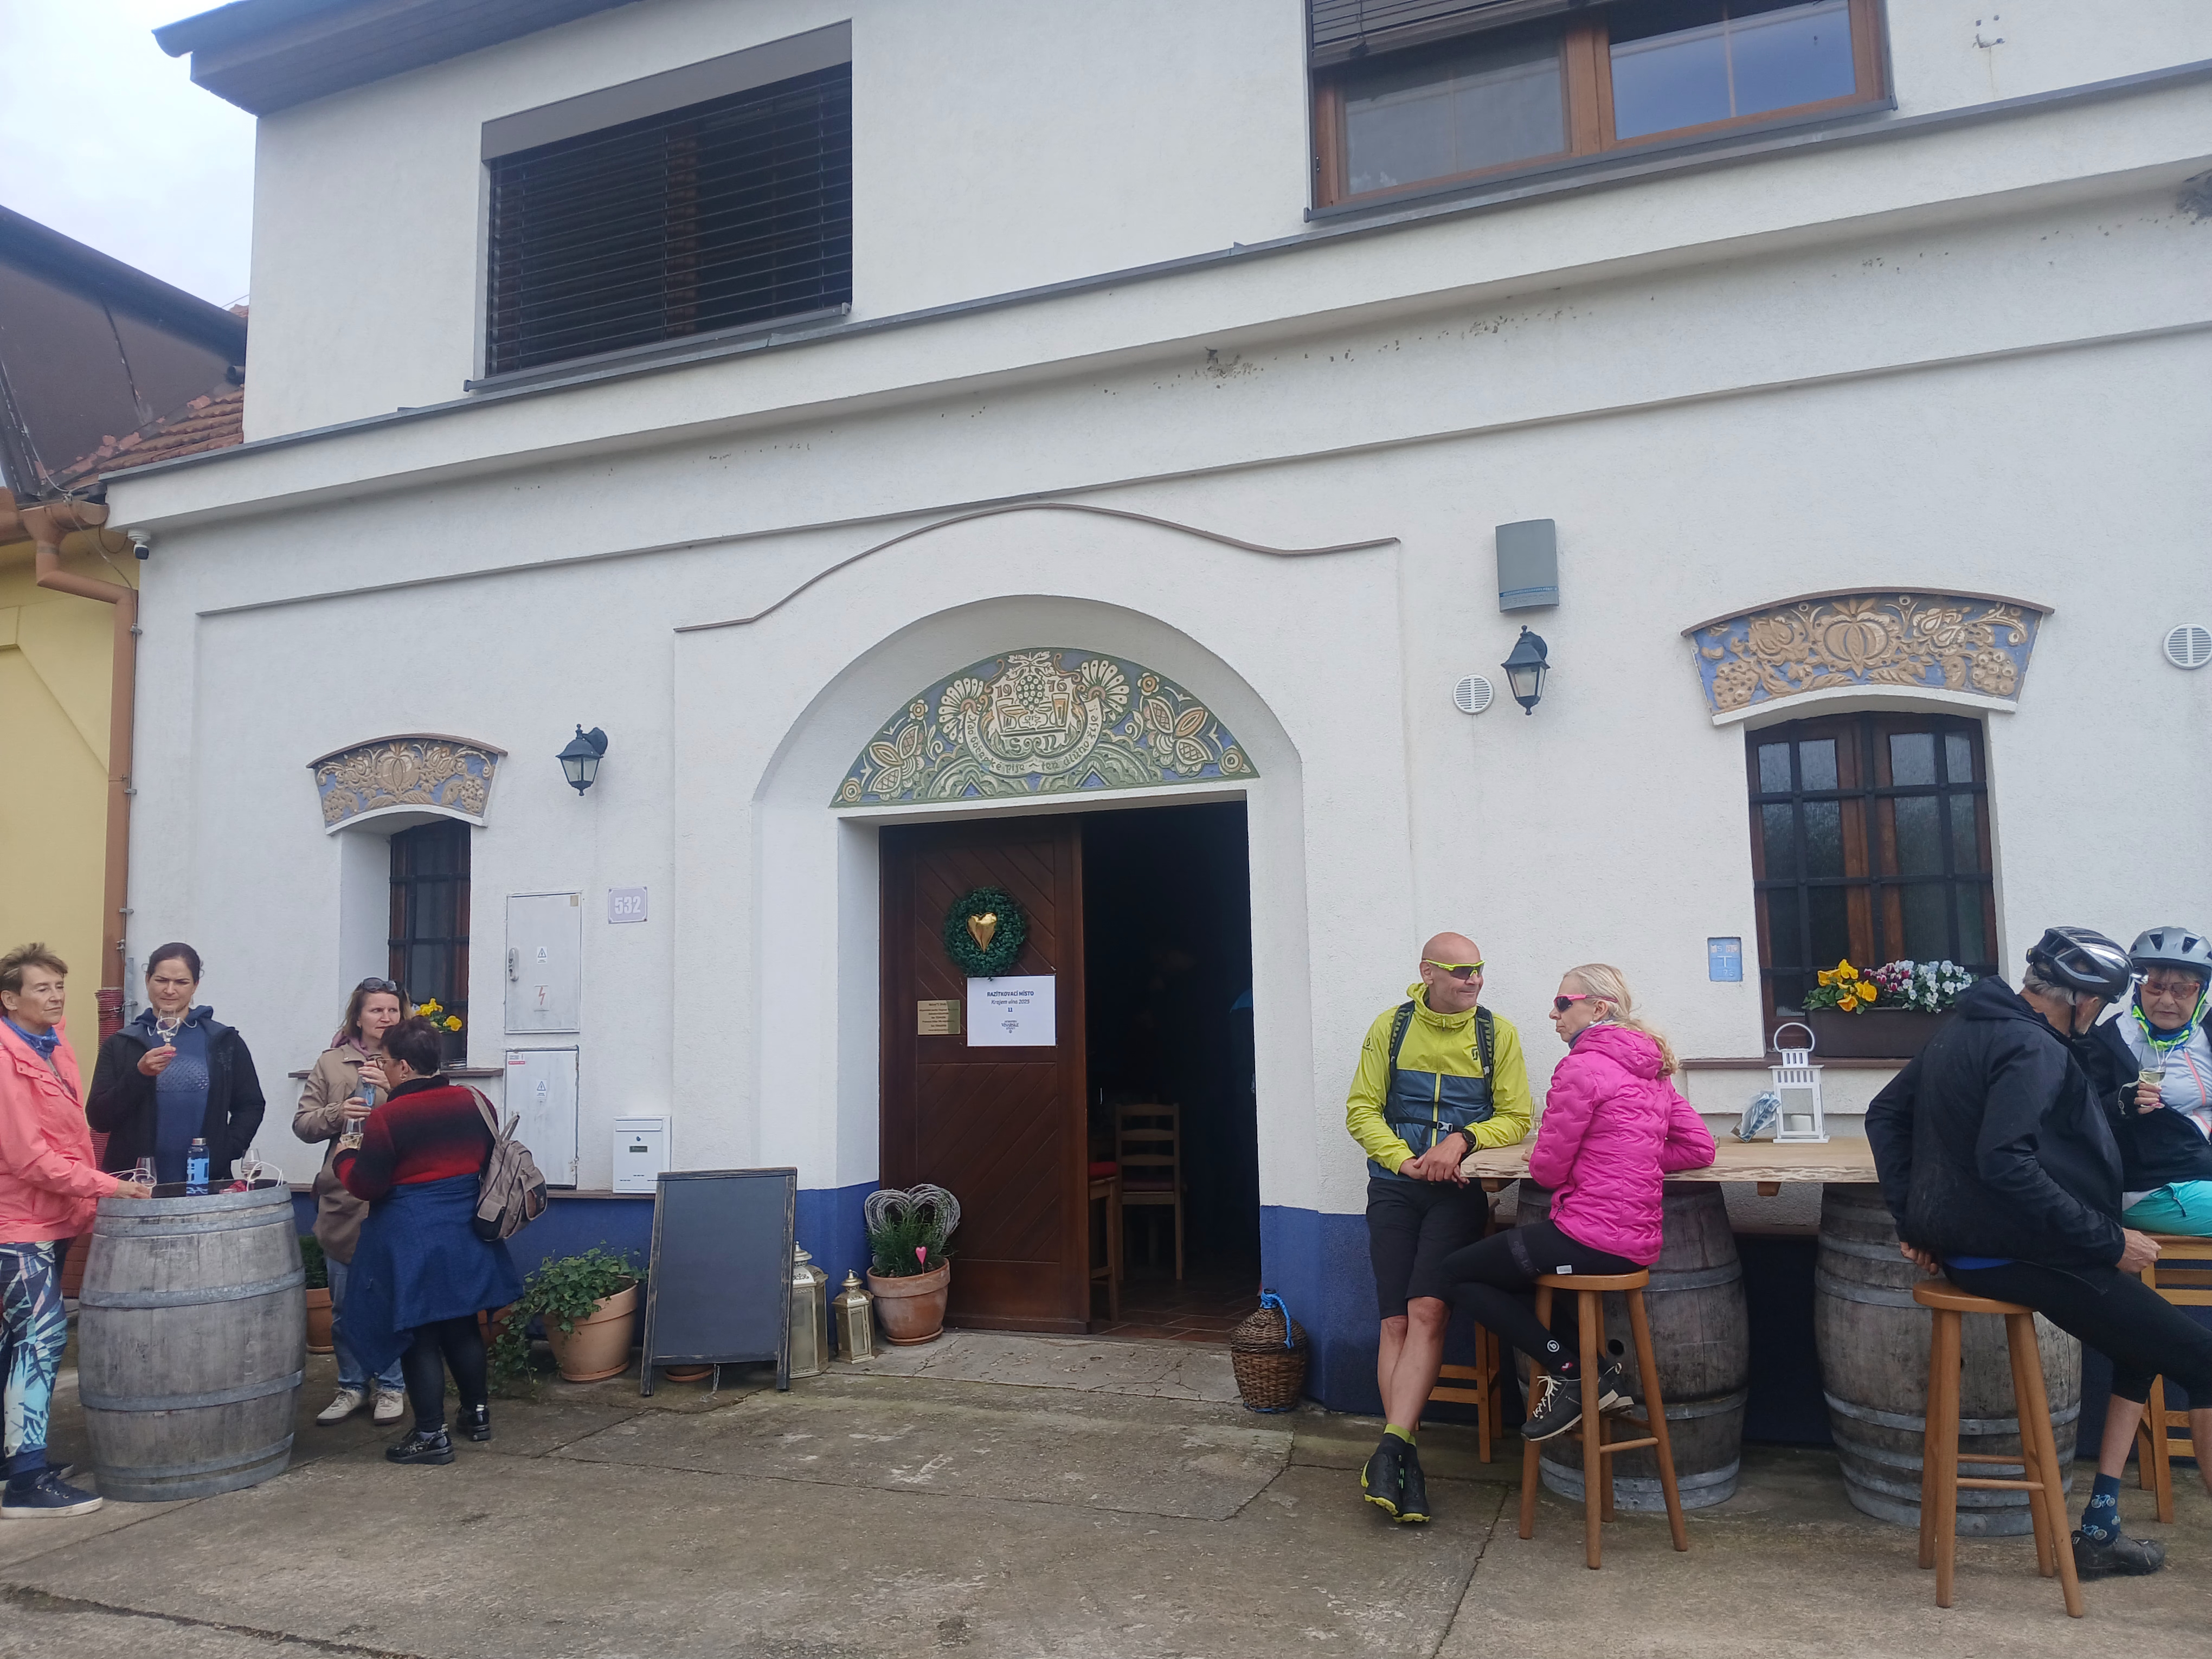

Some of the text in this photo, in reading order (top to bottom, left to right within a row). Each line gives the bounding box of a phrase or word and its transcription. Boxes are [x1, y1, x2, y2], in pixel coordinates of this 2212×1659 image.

[1005, 763, 1025, 774] pije
[614, 896, 641, 915] 532
[1717, 955, 1733, 968] T
